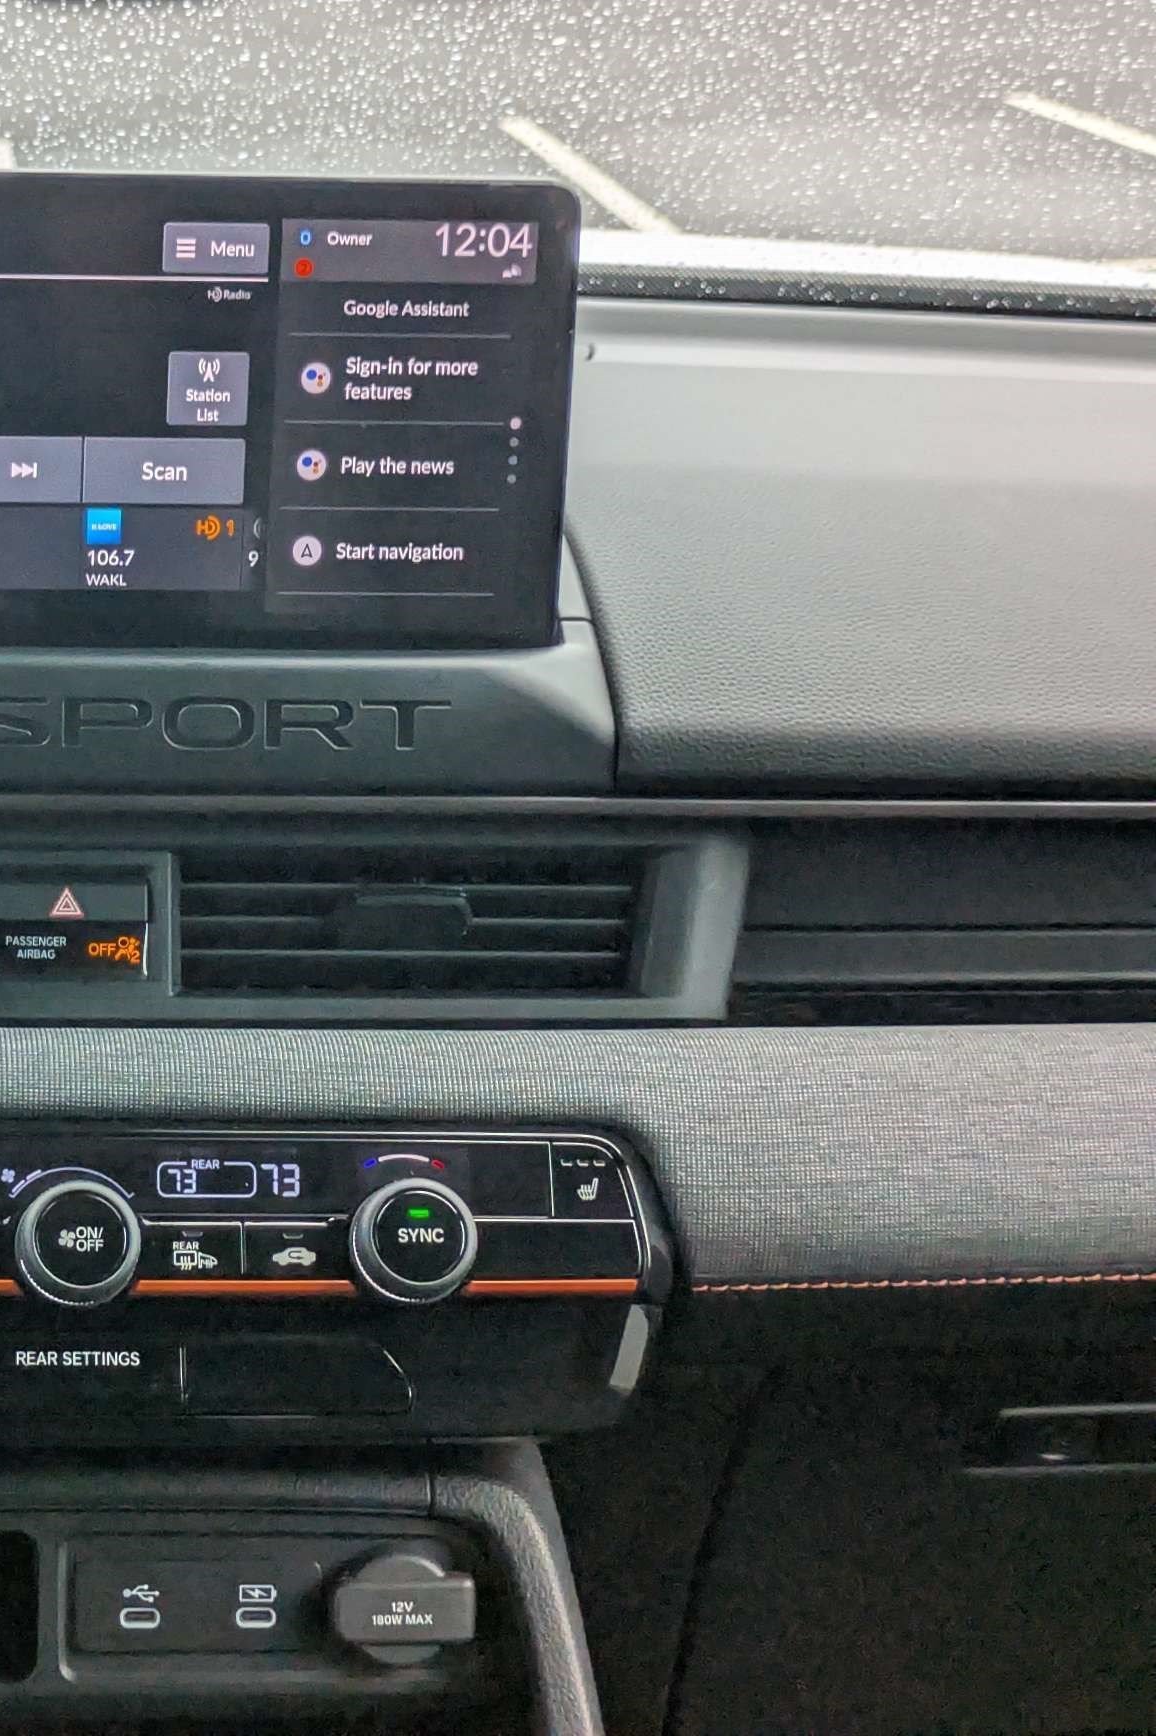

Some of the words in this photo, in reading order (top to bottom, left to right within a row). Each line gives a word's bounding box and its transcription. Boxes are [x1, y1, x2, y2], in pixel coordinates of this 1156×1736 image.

[327, 231, 372, 246] Owner
[436, 222, 532, 257] 12:04
[210, 240, 255, 257] Menu
[344, 300, 398, 318] Google
[401, 301, 470, 317] Assistant
[346, 356, 404, 378] Sign-in
[407, 357, 432, 376] for
[435, 361, 479, 376] more
[185, 388, 231, 403] Station
[344, 382, 413, 400] features
[196, 408, 220, 422] List
[141, 461, 188, 481] Scan
[340, 456, 376, 478] Play
[379, 457, 406, 475] the
[410, 461, 455, 475] news
[226, 519, 235, 537] 1
[87, 550, 135, 566] 106.7
[335, 543, 376, 560] Start
[379, 543, 464, 563] navigation
[85, 573, 127, 586] WAKL
[5, 935, 67, 947] PASSENGER
[16, 949, 56, 960] AIRBAG
[88, 942, 116, 957] OFF
[191, 1159, 220, 1170] REAR
[168, 1169, 197, 1193] 73
[261, 1163, 300, 1197] 73
[76, 1226, 103, 1239] ON/
[398, 1228, 445, 1244] SYNC
[76, 1239, 104, 1252] OFF
[172, 1241, 200, 1250] REAR
[16, 1351, 58, 1367] REAR
[62, 1351, 141, 1367] SETTINGS
[391, 1600, 414, 1612] 12V
[404, 1613, 434, 1626] MAX
